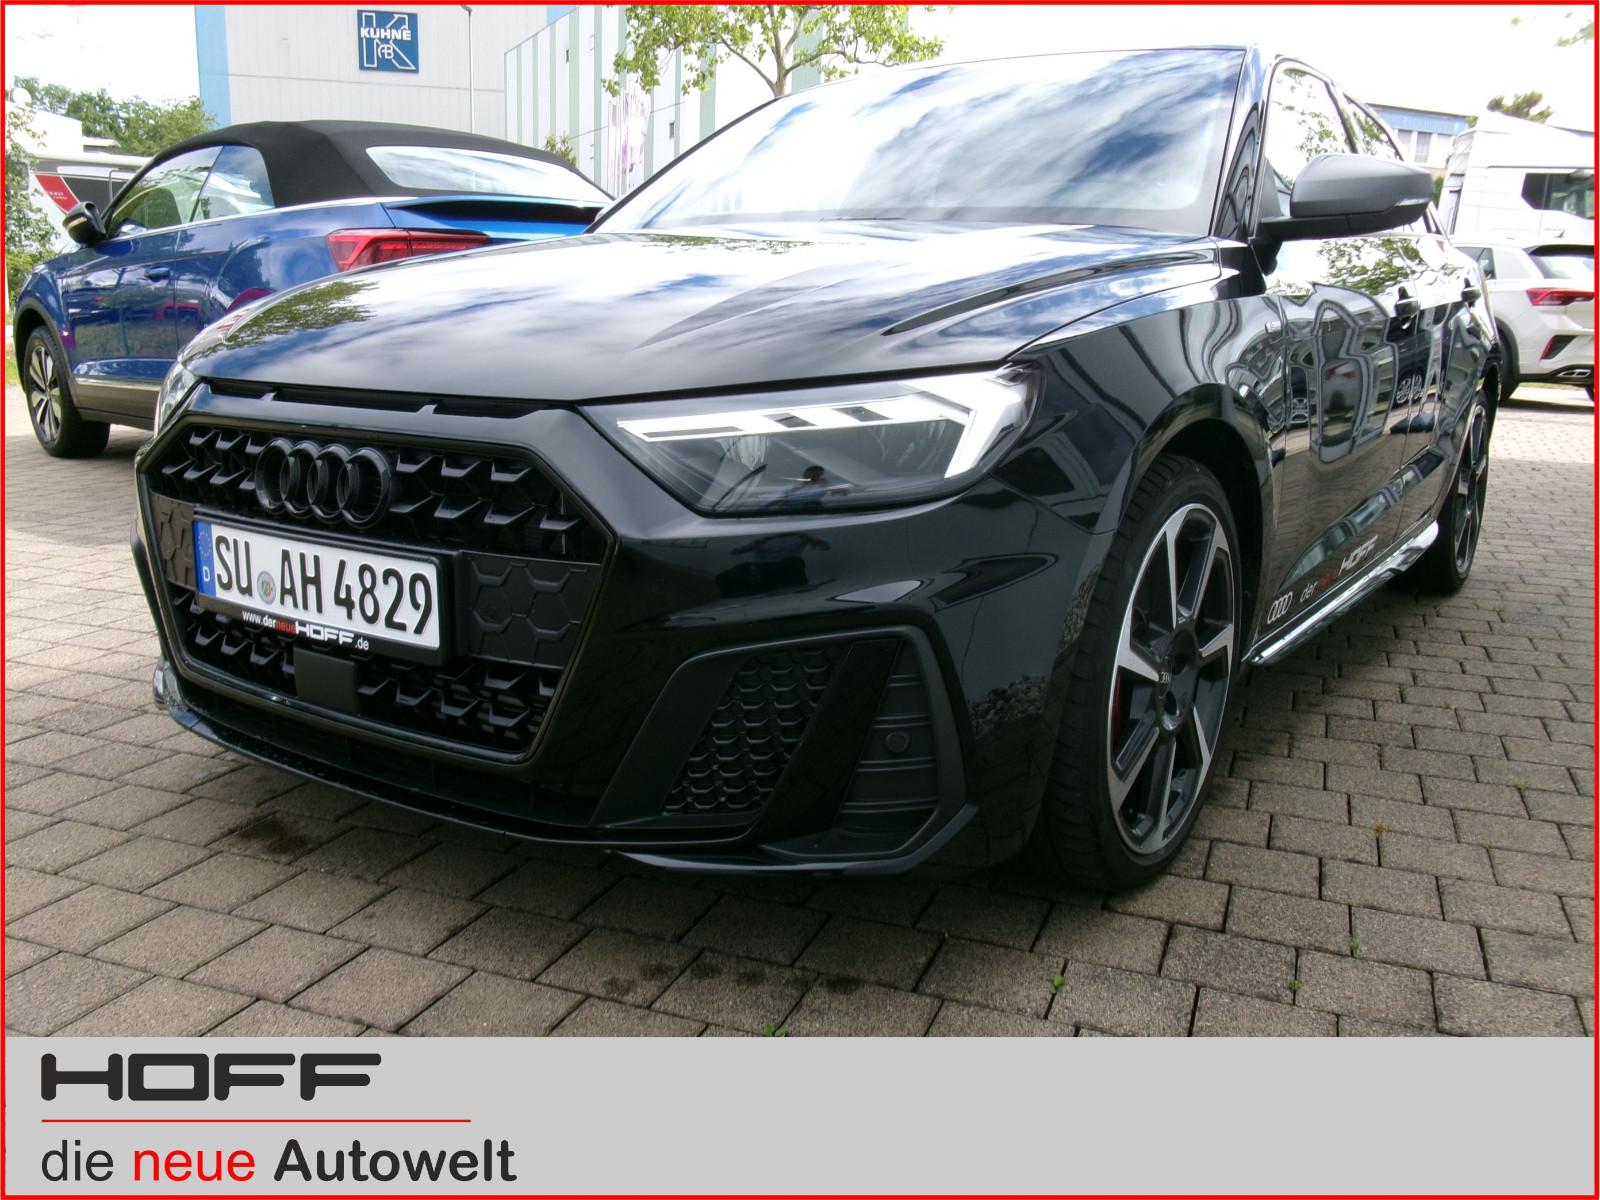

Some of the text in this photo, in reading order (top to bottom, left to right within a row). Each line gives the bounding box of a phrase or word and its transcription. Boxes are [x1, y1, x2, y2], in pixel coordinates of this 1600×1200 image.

[360, 27, 412, 41] KUHNE
[202, 566, 210, 582] D
[215, 535, 433, 635] SU AH 4829
